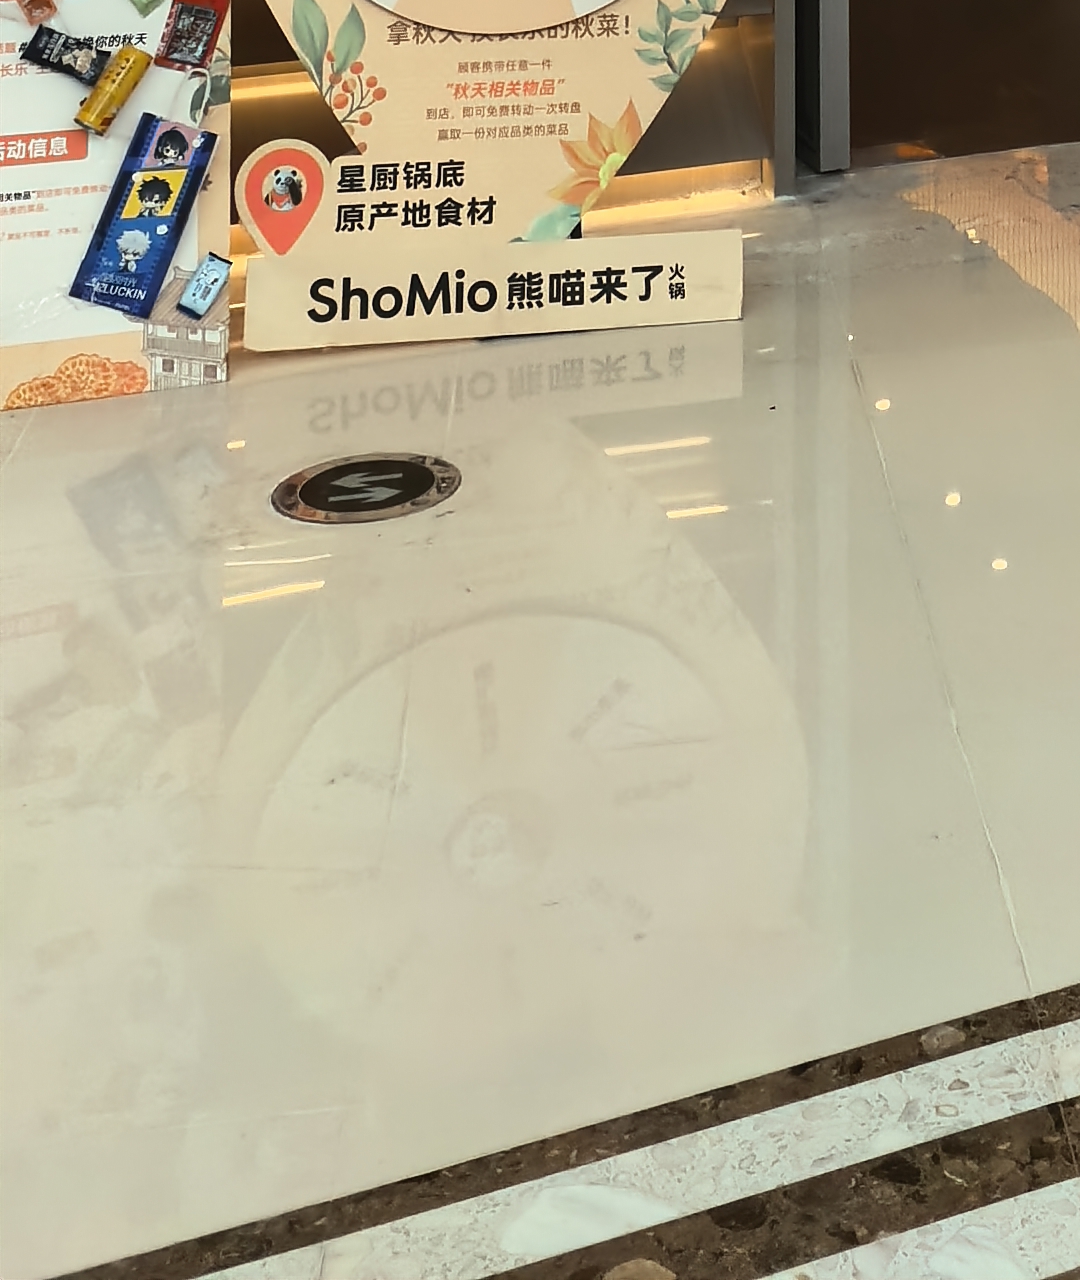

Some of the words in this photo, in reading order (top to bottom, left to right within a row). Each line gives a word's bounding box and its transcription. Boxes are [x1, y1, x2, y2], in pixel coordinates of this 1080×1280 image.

[457, 58, 553, 75] 顾客携带任意一件
[446, 78, 566, 100] “秋天相关物品”
[336, 159, 466, 194] 星厨锅底
[334, 195, 498, 233] 原产地食材
[306, 269, 499, 324] ShoMio
[505, 264, 664, 311] 熊喵来了
[668, 263, 687, 302] 火锅
